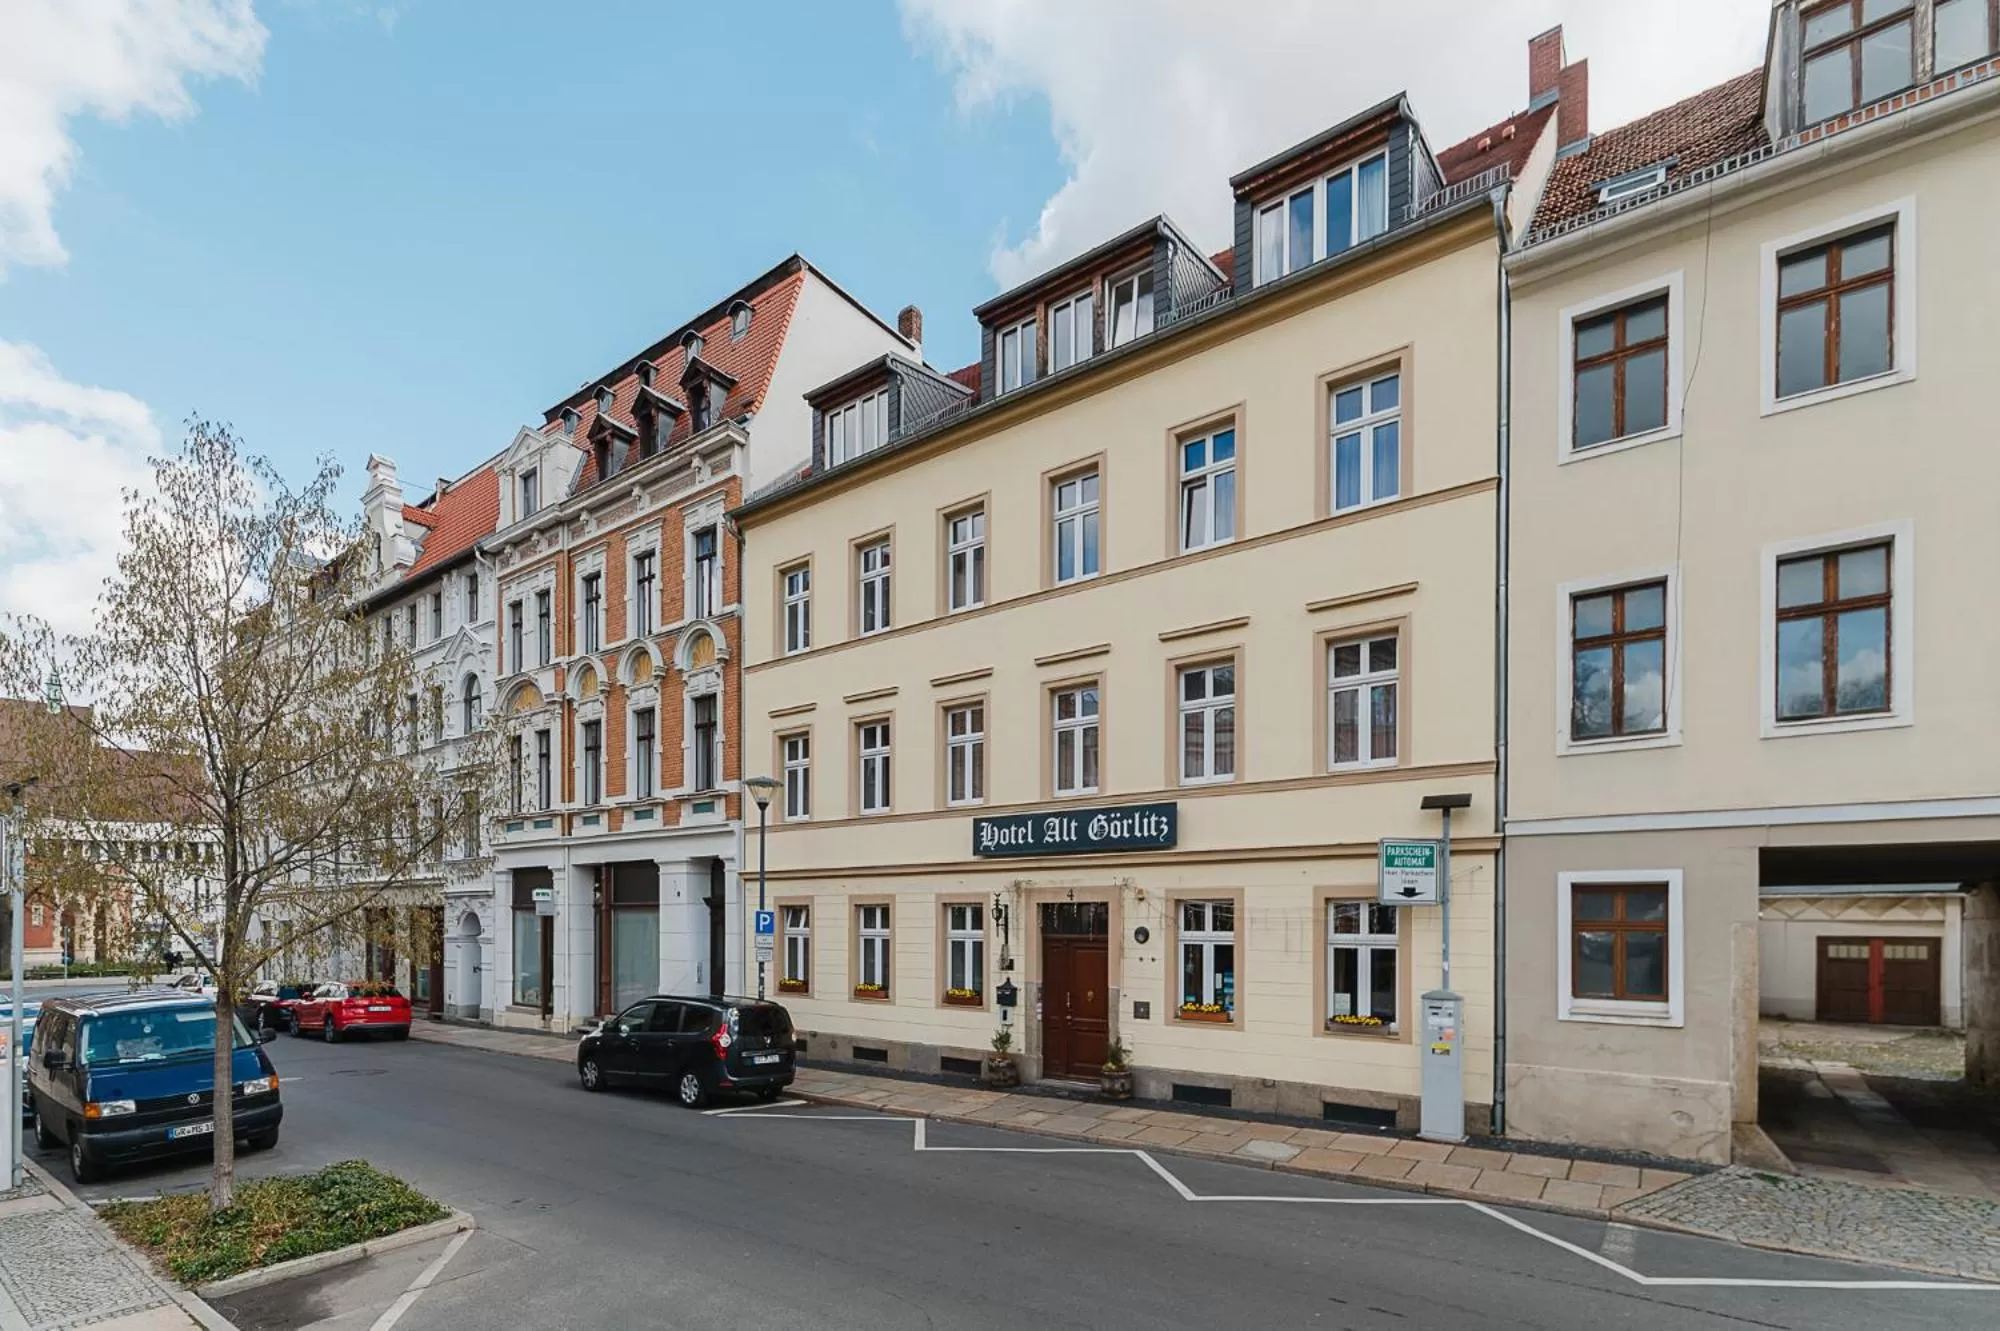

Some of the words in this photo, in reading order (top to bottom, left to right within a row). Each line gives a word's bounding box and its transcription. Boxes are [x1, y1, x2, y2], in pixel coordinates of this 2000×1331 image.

[979, 819, 1034, 851] Hotel
[1043, 816, 1078, 844] Alt
[1088, 811, 1169, 842] Görlitz
[1394, 857, 1426, 866] AUTOMAT
[1067, 888, 1074, 900] 4
[760, 913, 770, 931] P
